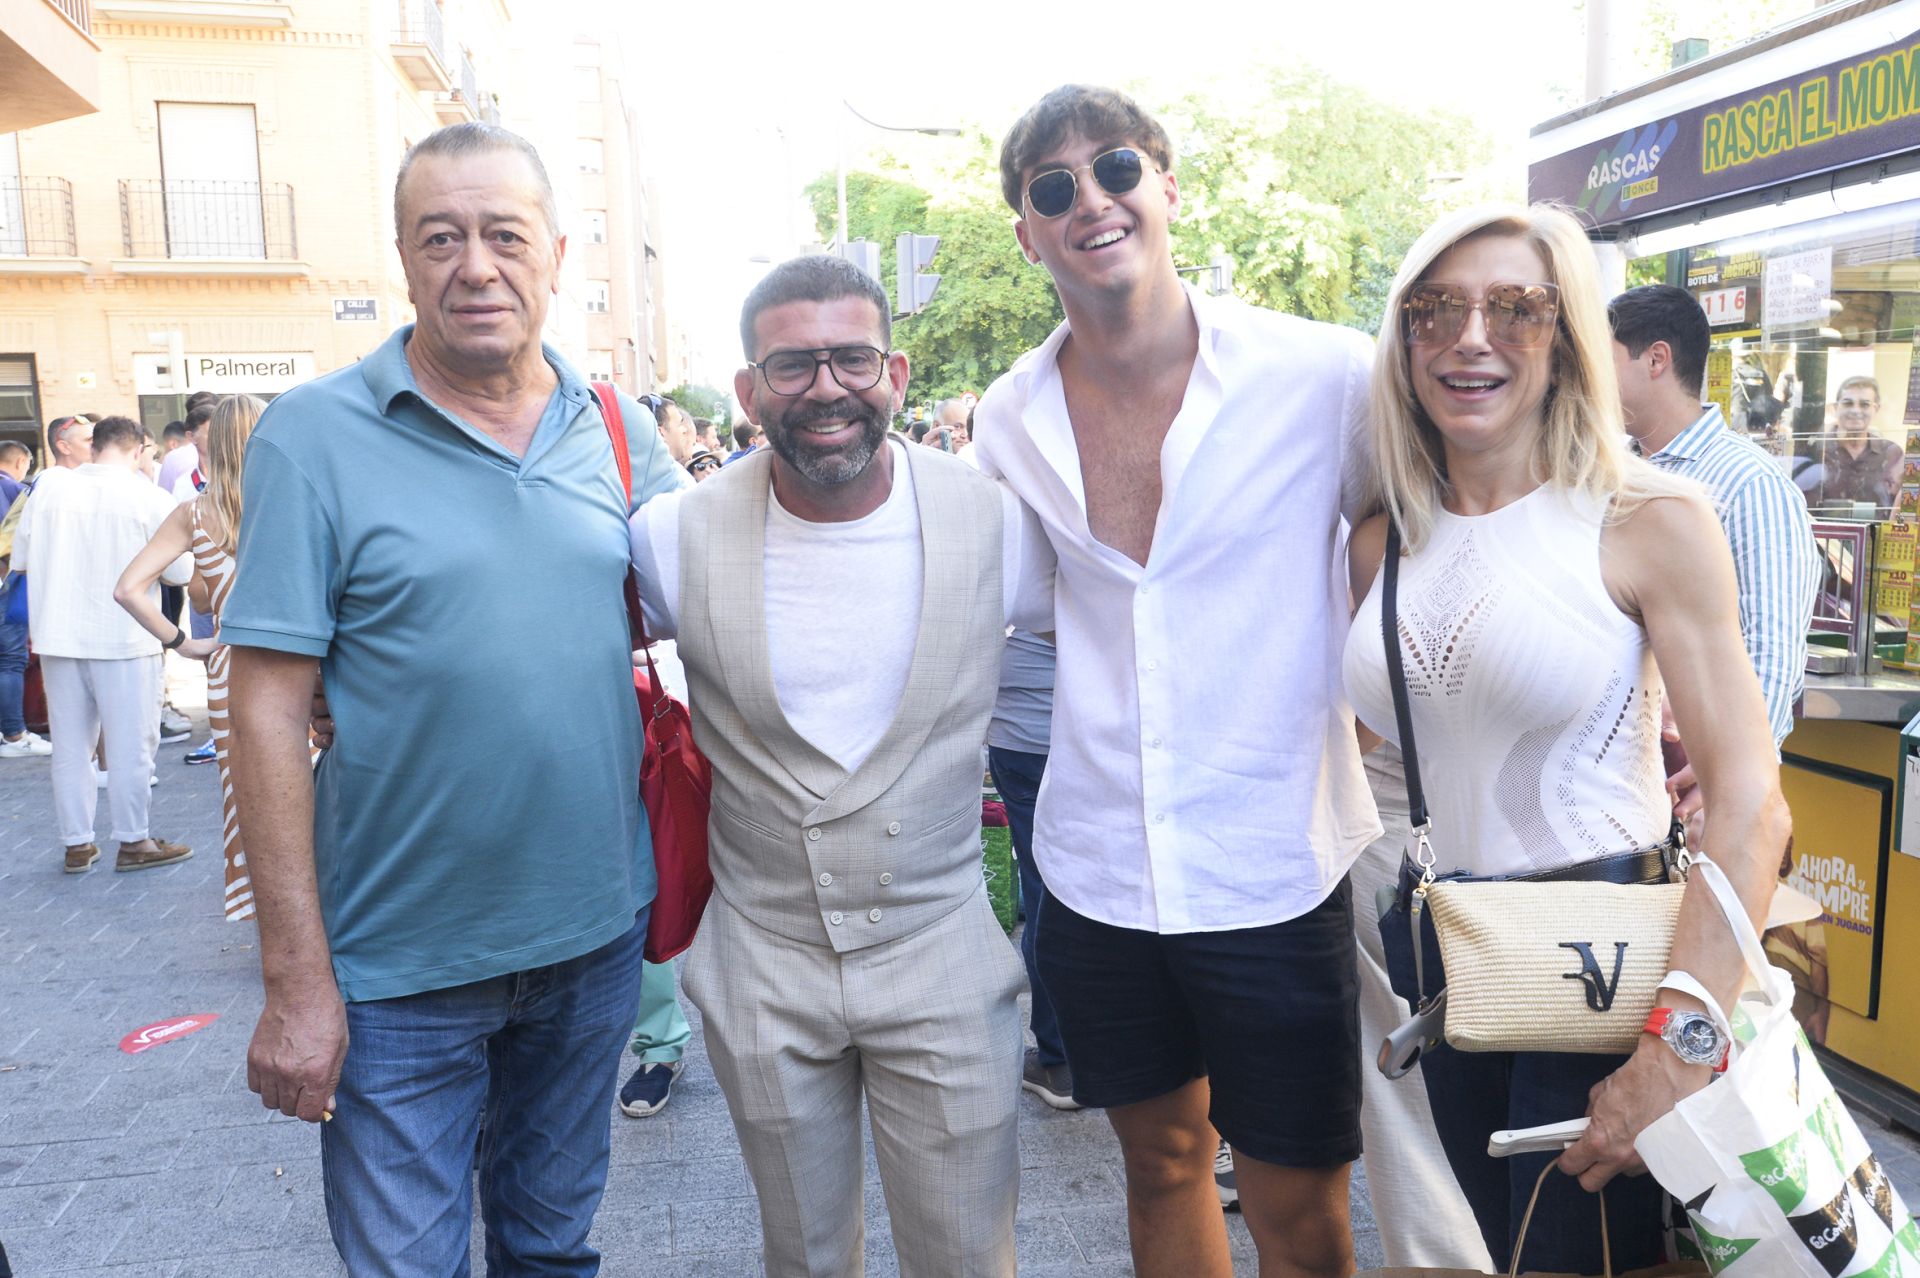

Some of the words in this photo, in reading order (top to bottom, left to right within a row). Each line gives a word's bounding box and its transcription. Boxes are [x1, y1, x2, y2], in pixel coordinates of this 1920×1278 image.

[1703, 88, 1795, 174] RASCA
[1798, 76, 1836, 147] EL
[1587, 144, 1661, 190] RASCAS
[1631, 180, 1657, 196] ONCE
[1687, 274, 1707, 287] BOTE
[1708, 272, 1719, 284] DE
[200, 357, 295, 377] Palmeral
[1799, 853, 1857, 888] AHORA
[1836, 916, 1873, 936] JUGADO
